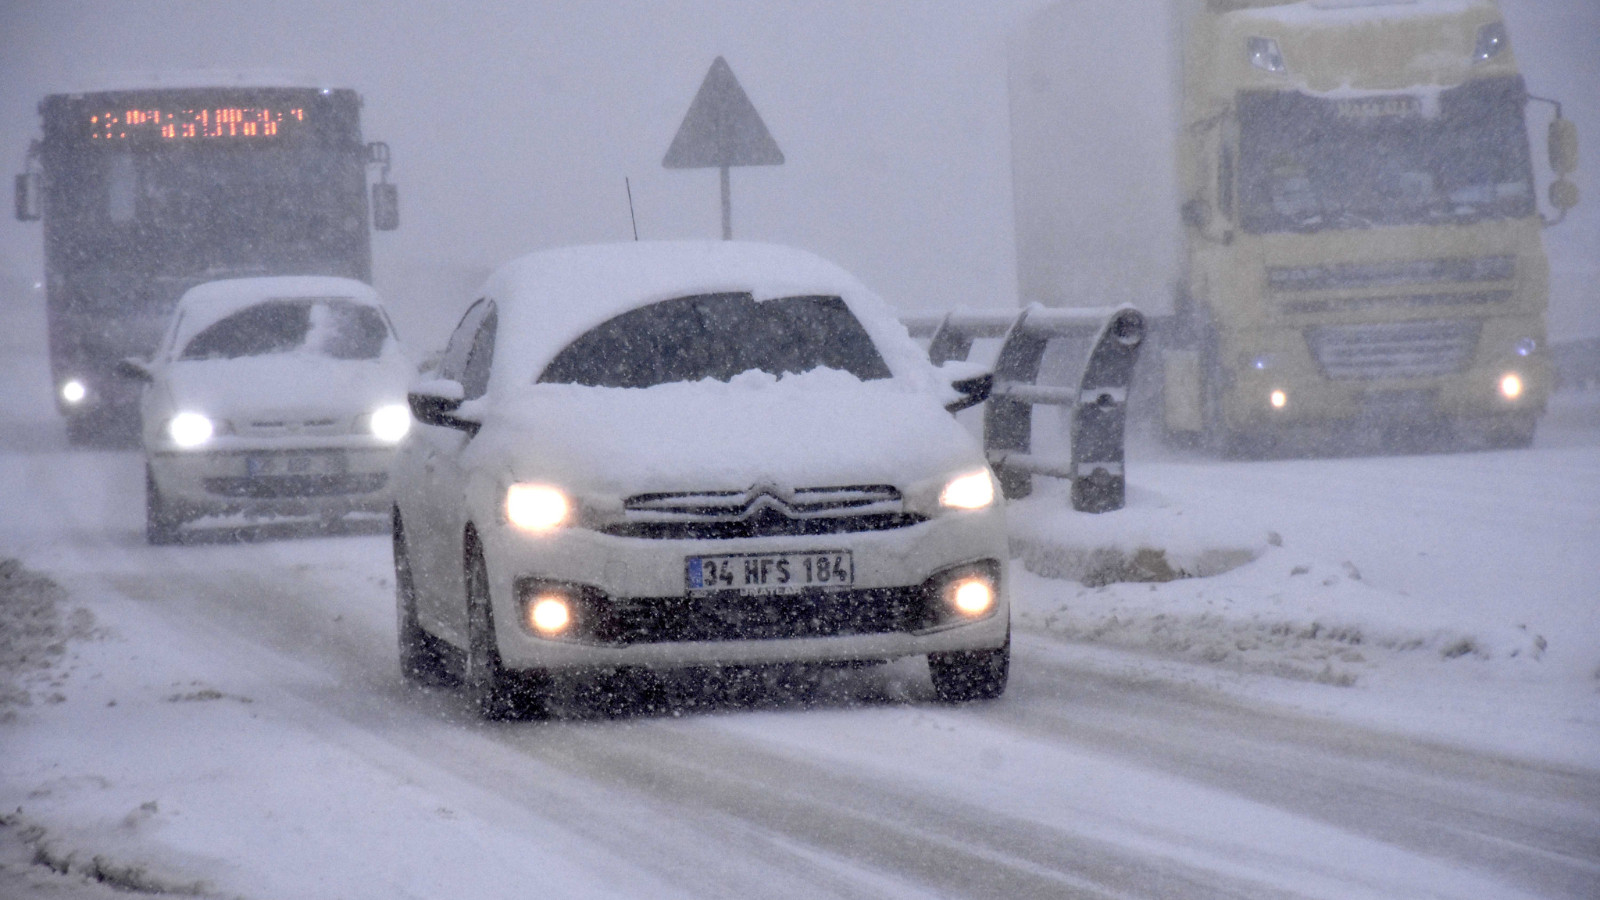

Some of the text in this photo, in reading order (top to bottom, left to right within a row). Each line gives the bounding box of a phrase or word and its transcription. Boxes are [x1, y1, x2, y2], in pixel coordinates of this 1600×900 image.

[703, 556, 848, 587] 34 HFS 184
